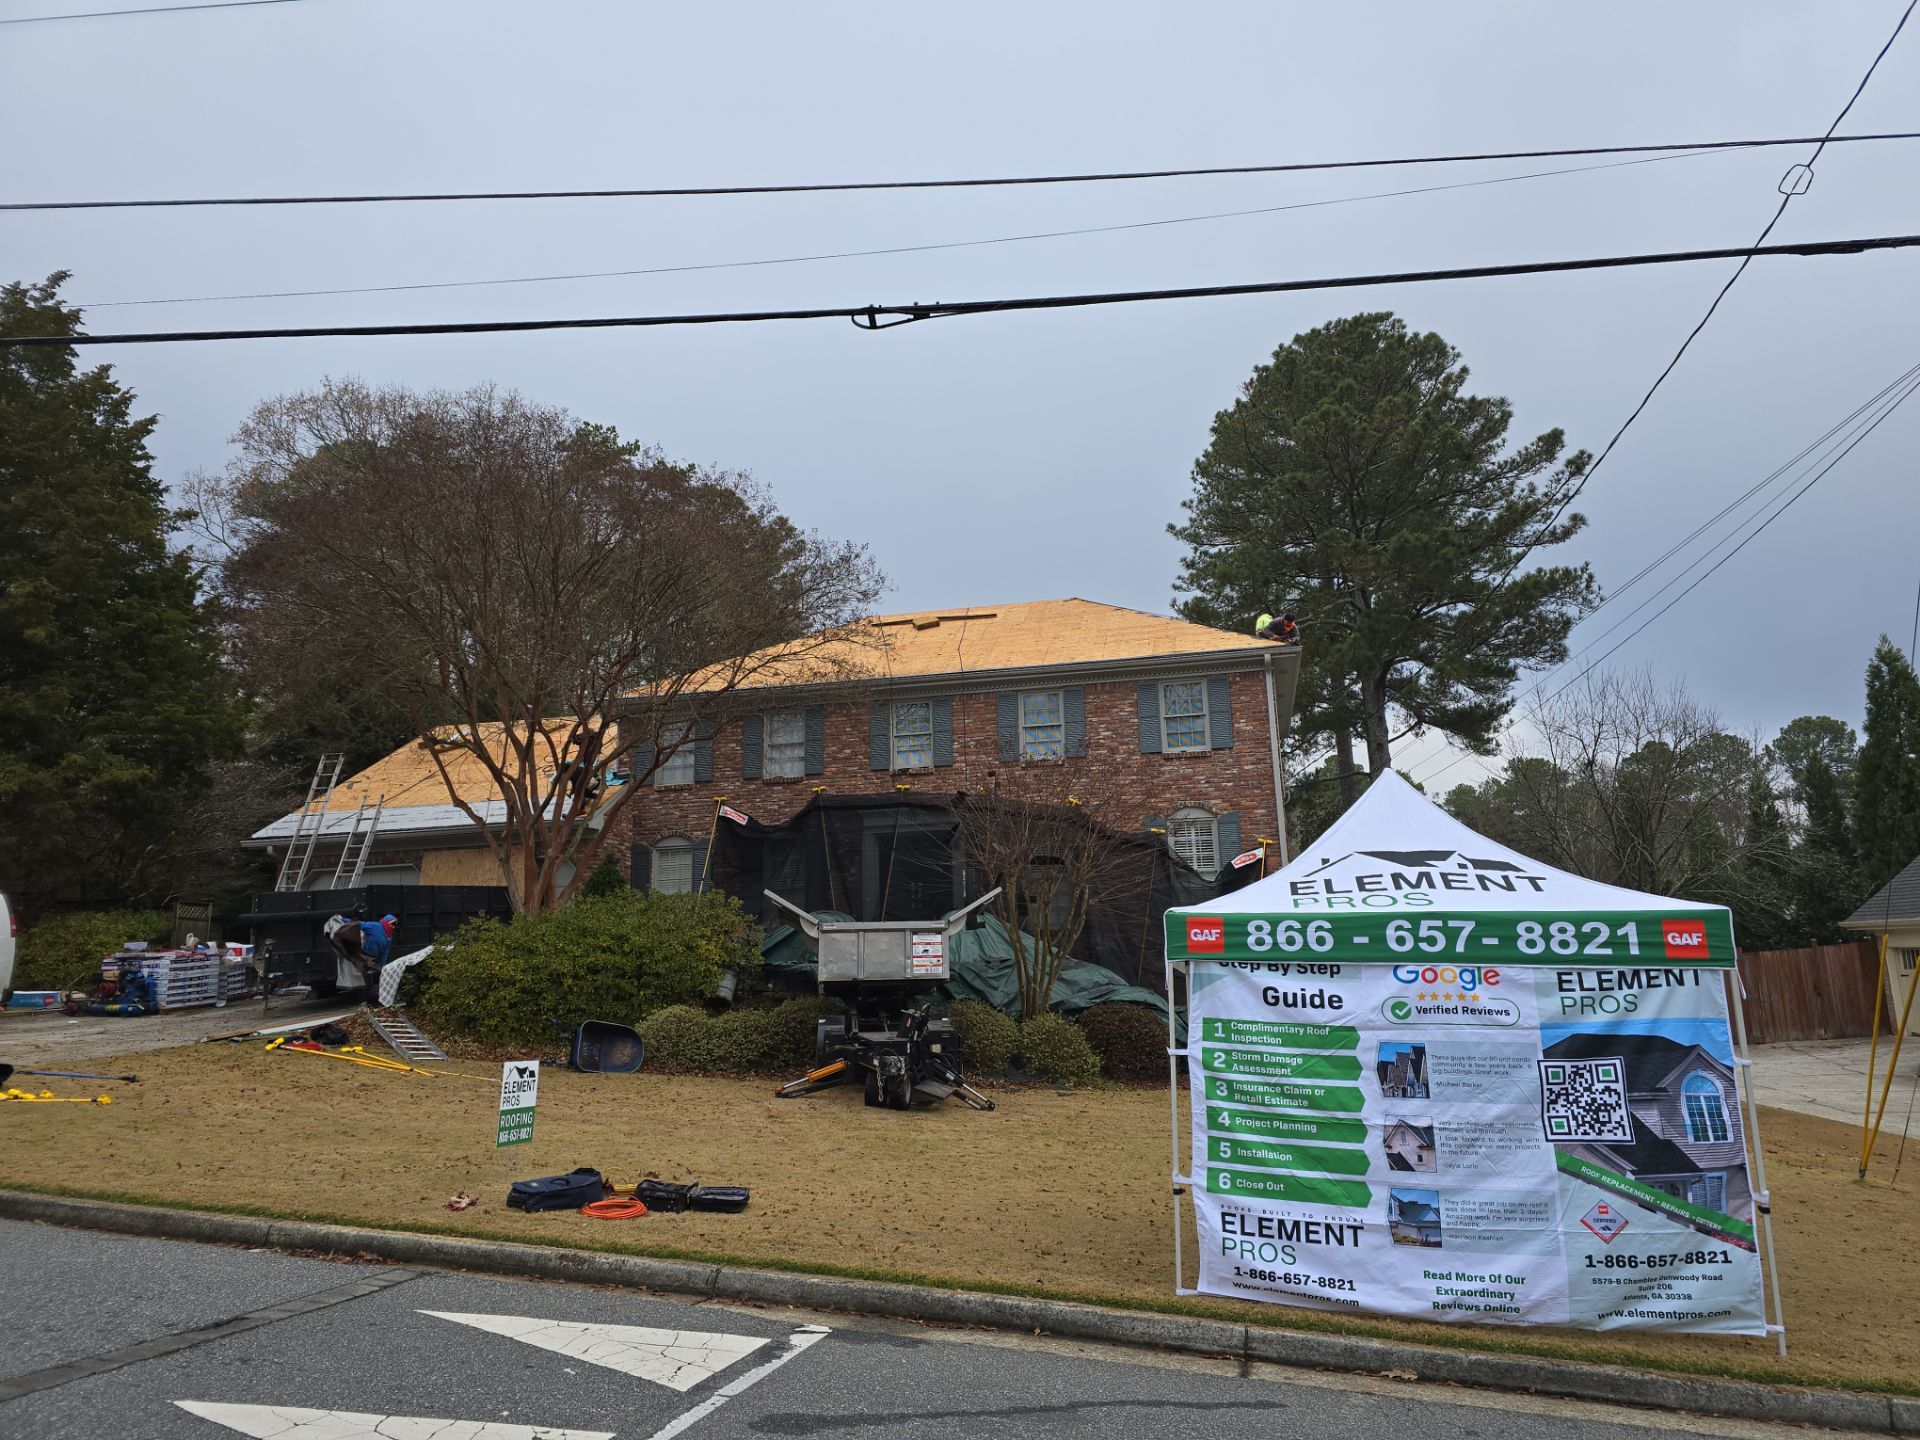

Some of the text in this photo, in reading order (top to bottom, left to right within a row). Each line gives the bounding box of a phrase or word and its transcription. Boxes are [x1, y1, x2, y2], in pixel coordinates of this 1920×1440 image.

[1289, 871, 1547, 896] ELEMENT
[1292, 892, 1434, 908] PROS
[1190, 929, 1221, 941] GAF
[1246, 919, 1334, 952] 866
[1516, 920, 1640, 955] 8821
[1667, 932, 1702, 946] GAF
[1267, 962, 1291, 976] By
[1296, 963, 1340, 978] Step
[1392, 965, 1501, 991] Google
[1262, 986, 1343, 1010] Guide
[1560, 993, 1638, 1015] PROS
[1415, 1005, 1511, 1017] Verified Reviews
[1214, 1021, 1330, 1037] 1 Complimentary Roof
[1231, 1033, 1282, 1046] Inspection
[1213, 1052, 1303, 1068] 2 Storm Damage
[1232, 1063, 1292, 1076] Assessment
[503, 1079, 536, 1095] ELEMENT
[1215, 1081, 1325, 1097] 3 Insurance Claim or
[502, 1095, 520, 1107] PROS
[1234, 1093, 1309, 1107] Retail Estimate
[500, 1111, 533, 1128] ROOFING
[1217, 1111, 1317, 1133] 4 Project Planning
[1219, 1142, 1292, 1161] 5 Installation
[1218, 1172, 1284, 1192] 6 Close Out
[1580, 1166, 1601, 1179] ROOF
[1601, 1176, 1655, 1203] REPLACEMENT
[1660, 1202, 1690, 1218] REPAIRS
[1262, 1209, 1291, 1217] BUILT
[1220, 1211, 1365, 1247] ELEMENT
[1222, 1237, 1297, 1265] PROS
[1584, 1250, 1732, 1269] 1-866-657-8821
[1234, 1266, 1357, 1291] 1-866-657-8821
[1423, 1270, 1526, 1285] Read More Of Our
[1592, 1277, 1622, 1285] 5579-B
[1435, 1286, 1515, 1301] Extraordinary
[1665, 1293, 1693, 1301] 30338
[1432, 1301, 1521, 1314] Reviews Online
[1597, 1308, 1731, 1321] www.elementpros.com
